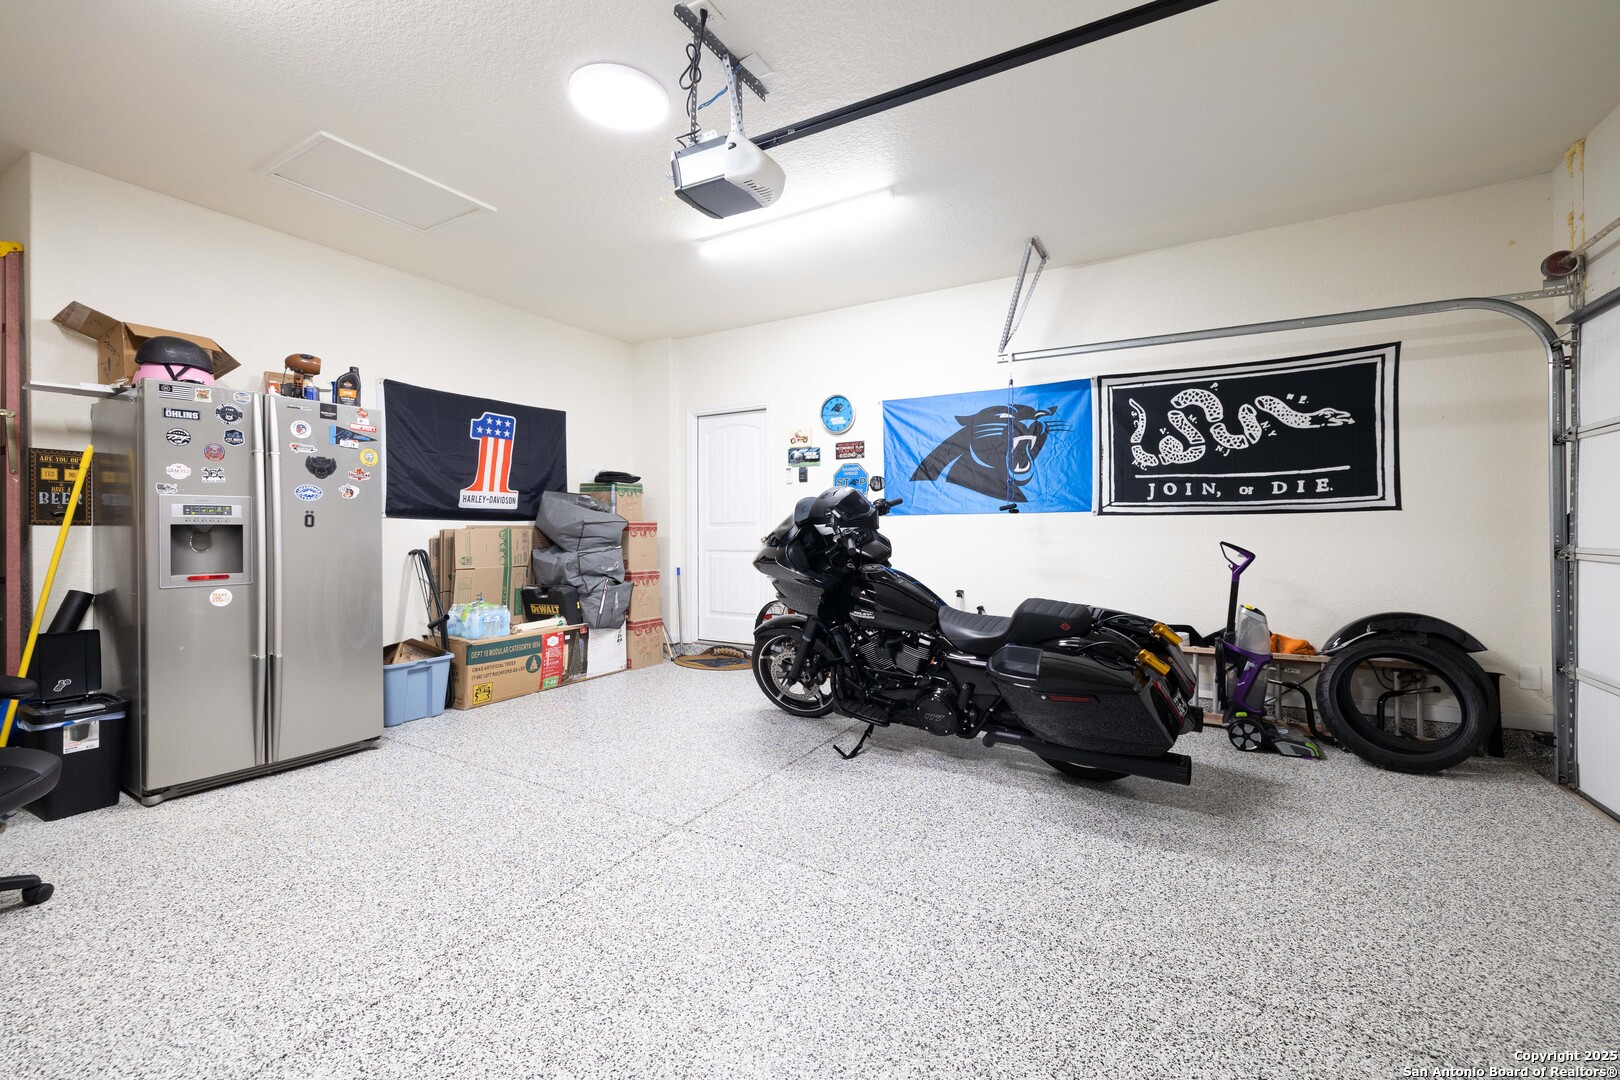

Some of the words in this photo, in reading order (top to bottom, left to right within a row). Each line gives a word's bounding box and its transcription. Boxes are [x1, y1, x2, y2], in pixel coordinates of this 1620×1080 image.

[165, 408, 198, 420] ÖHLINS
[1147, 482, 1221, 500] JOIN,
[1239, 486, 1254, 495] or
[1271, 478, 1334, 494] DIE.
[462, 495, 516, 504] HARLEY-DAVIDSON
[304, 510, 314, 527] Ö
[471, 650, 483, 659] DEPT
[489, 646, 509, 656] MODULAR
[484, 662, 504, 671] ARTIFICIAL
